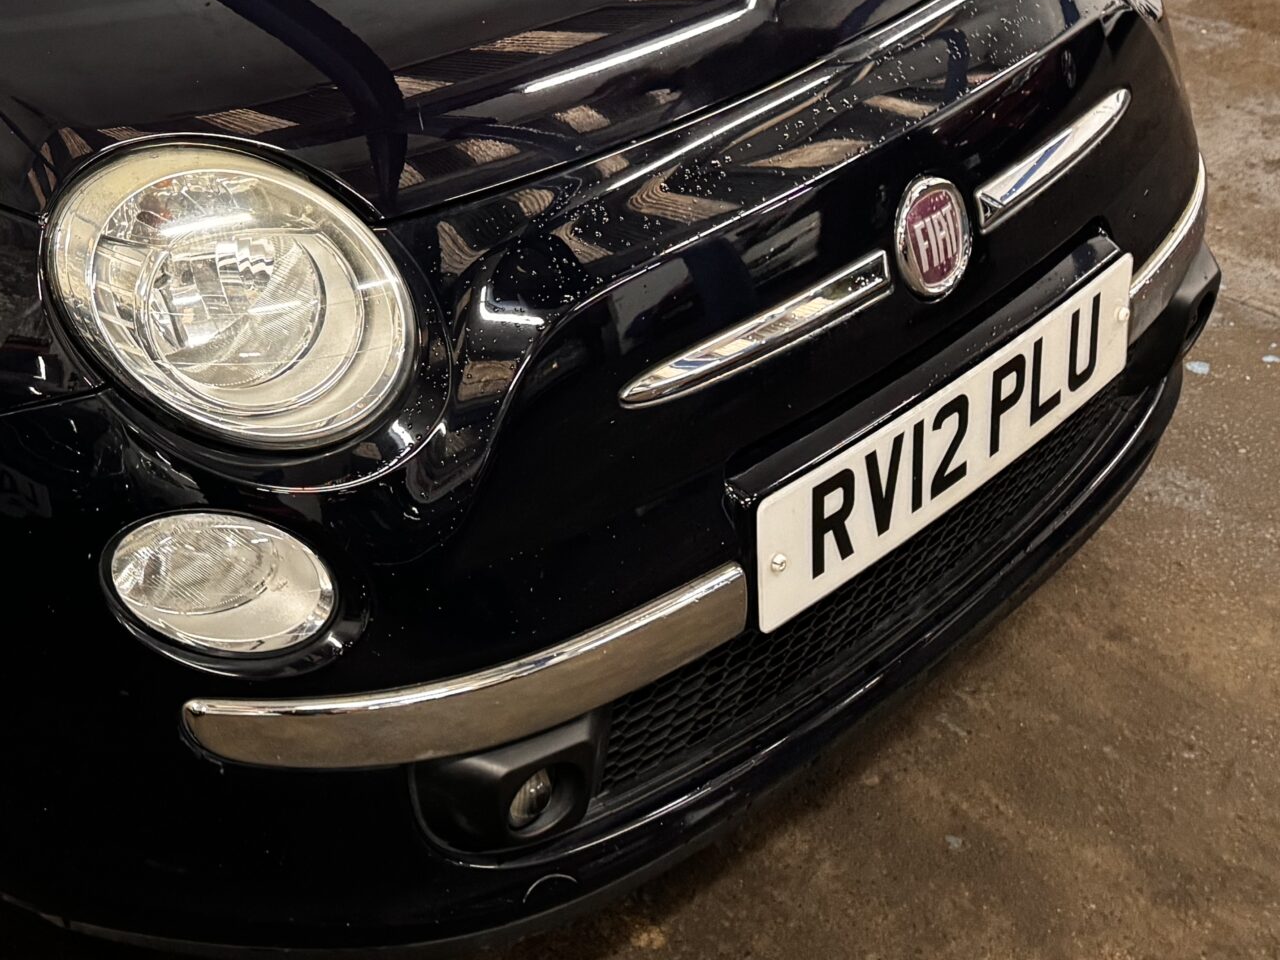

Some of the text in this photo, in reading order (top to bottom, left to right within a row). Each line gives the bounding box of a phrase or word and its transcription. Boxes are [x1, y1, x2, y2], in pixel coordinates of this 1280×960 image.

[913, 201, 958, 273] FIAT
[811, 292, 1102, 580] RV12 PLU
